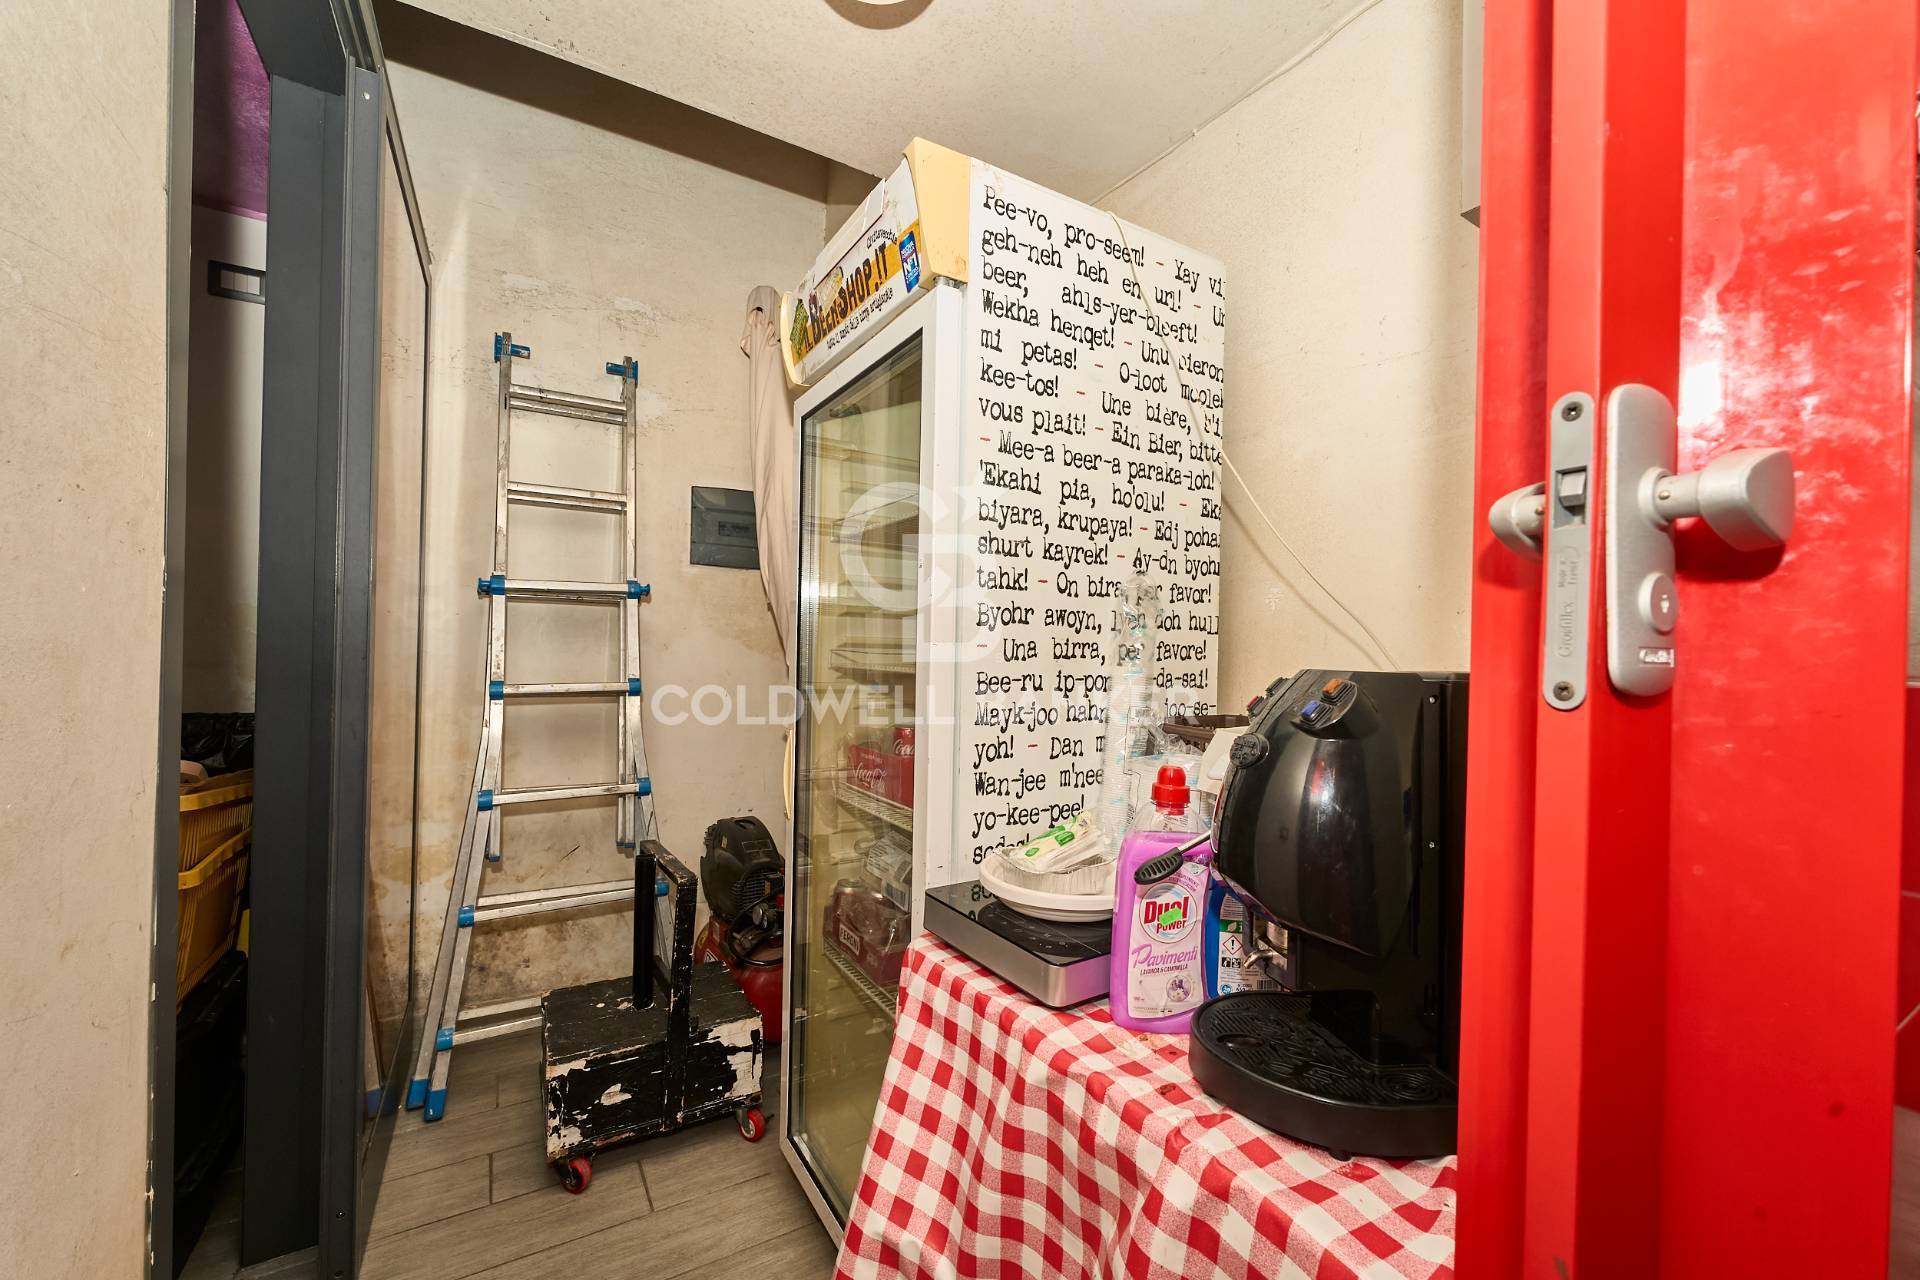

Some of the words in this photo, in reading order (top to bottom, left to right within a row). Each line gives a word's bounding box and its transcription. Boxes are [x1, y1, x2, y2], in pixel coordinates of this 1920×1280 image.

[982, 227, 1062, 268] geh-neh
[1077, 253, 1109, 284] heh
[1122, 277, 1141, 299] en
[983, 185, 1052, 240] Pee-vo,
[1064, 223, 1145, 267] pro-seem!
[1174, 258, 1200, 293] Yay
[1208, 277, 1226, 300] vi
[981, 255, 1029, 298] beer,
[982, 289, 1040, 327] Wekha
[1050, 309, 1115, 350] henqet!
[1141, 340, 1170, 366] Unu
[980, 328, 1003, 353] mi
[1021, 339, 1078, 370] petas!
[1119, 361, 1168, 394] O-loot
[980, 356, 1060, 398] kee-tos!
[1101, 390, 1131, 416] Une
[1146, 400, 1192, 436] bière,
[979, 397, 1023, 423] vous
[1031, 410, 1086, 436] plait!
[1111, 421, 1141, 450] Ein
[1147, 432, 1184, 462] Bier,
[998, 429, 1055, 462] Mee-a
[1062, 444, 1121, 474] beer-a
[1127, 459, 1215, 491] paraka-loh!
[980, 459, 1042, 495] 'Ekahi
[1059, 478, 1096, 508] pia,
[1112, 482, 1165, 513] ho'olu!
[978, 496, 1051, 535] biyara,
[1056, 506, 1133, 543] krupaya!
[1154, 519, 1180, 550] Edj
[977, 530, 1034, 558] shurt
[1042, 536, 1109, 570] kayrek!
[1133, 547, 1178, 576] Ay-dn
[977, 565, 1029, 592] tahk!
[1056, 571, 1079, 598] On
[1169, 583, 1211, 605] favor!
[976, 602, 1035, 632] Byohr
[1044, 608, 1103, 635] awoyn,
[1003, 638, 1038, 662] Una
[1051, 636, 1106, 667] birra,
[1117, 642, 1145, 667] per
[1156, 639, 1207, 662] favore!
[975, 670, 1044, 696] Bee-ru
[974, 701, 1059, 733] Mayk-joo
[973, 734, 1015, 769] yoh!
[1049, 736, 1084, 760] Dan
[974, 768, 1047, 800] Wan-jee
[972, 794, 1086, 839] yo-kee-pee!
[1131, 944, 1199, 969] Pavimenti
